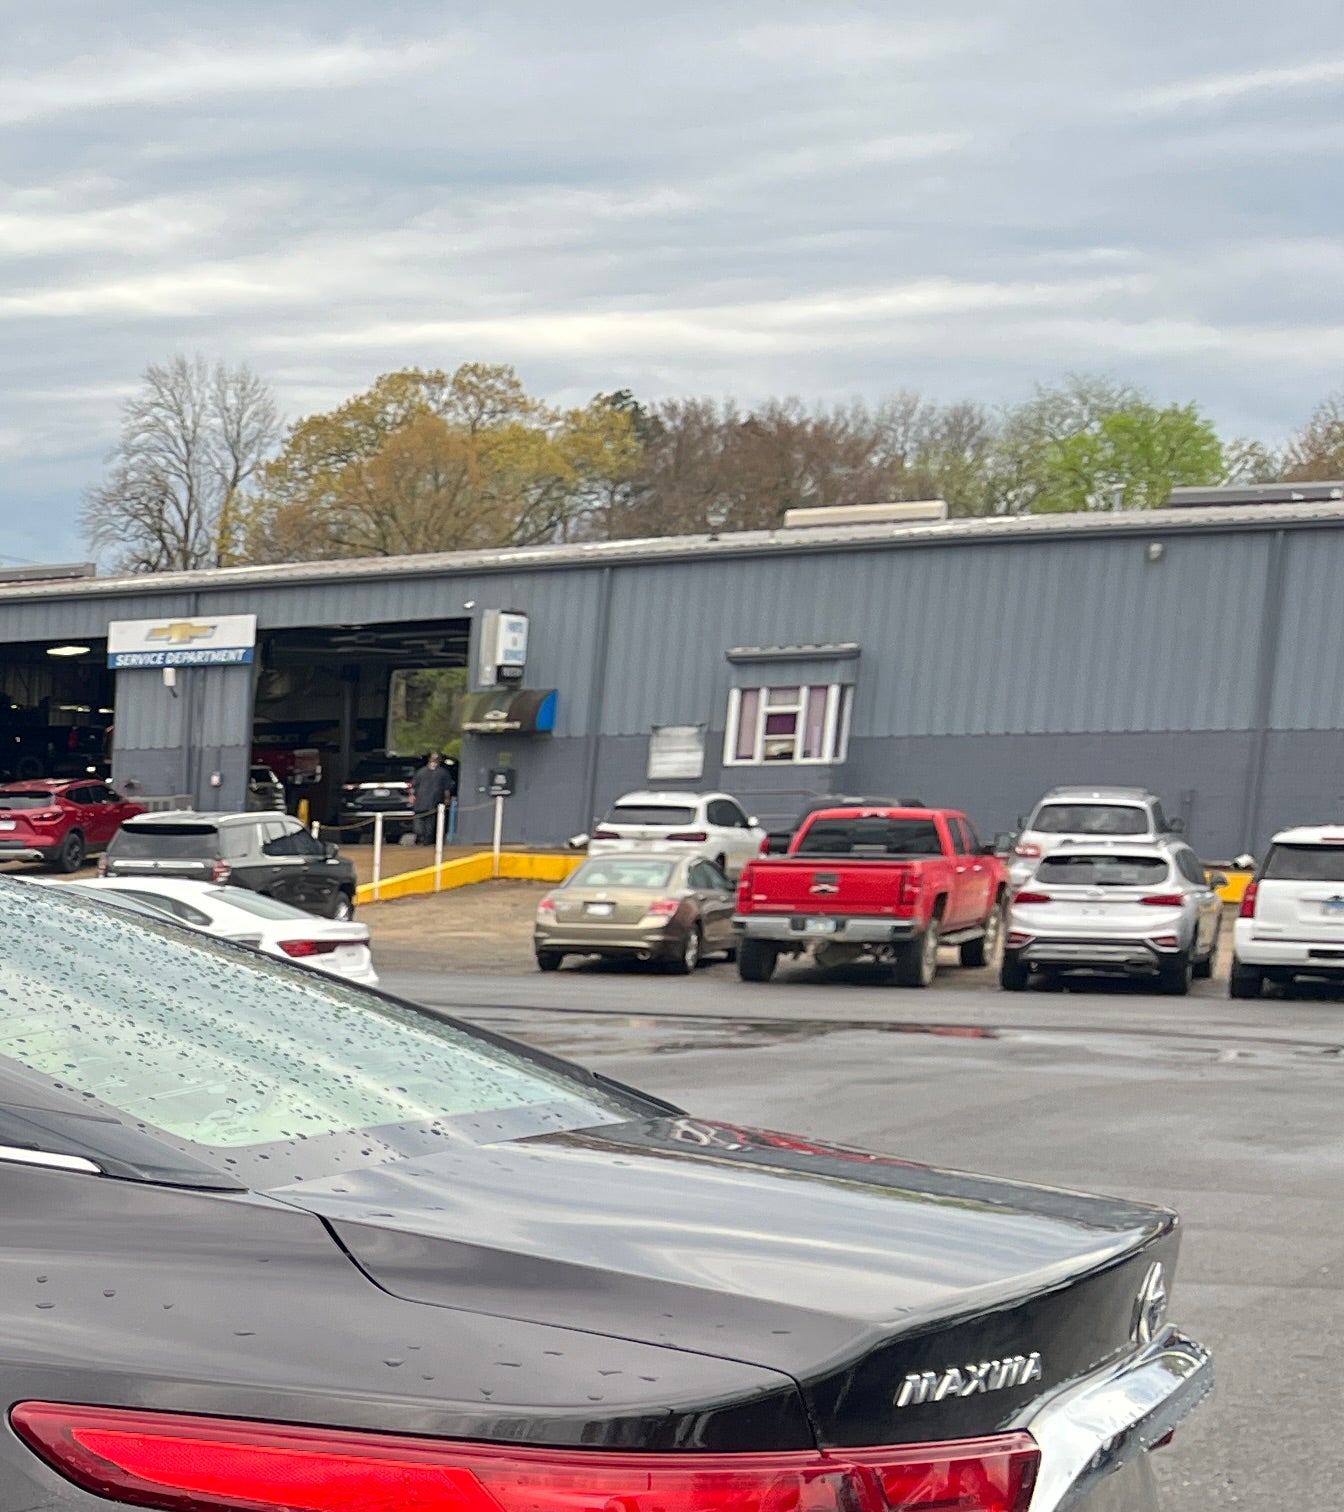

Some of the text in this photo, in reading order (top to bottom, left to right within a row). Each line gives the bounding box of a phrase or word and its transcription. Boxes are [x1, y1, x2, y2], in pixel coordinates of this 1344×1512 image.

[115, 649, 245, 666] SERVICE DEPARTMENT
[894, 1351, 1043, 1407] MAXIMA
